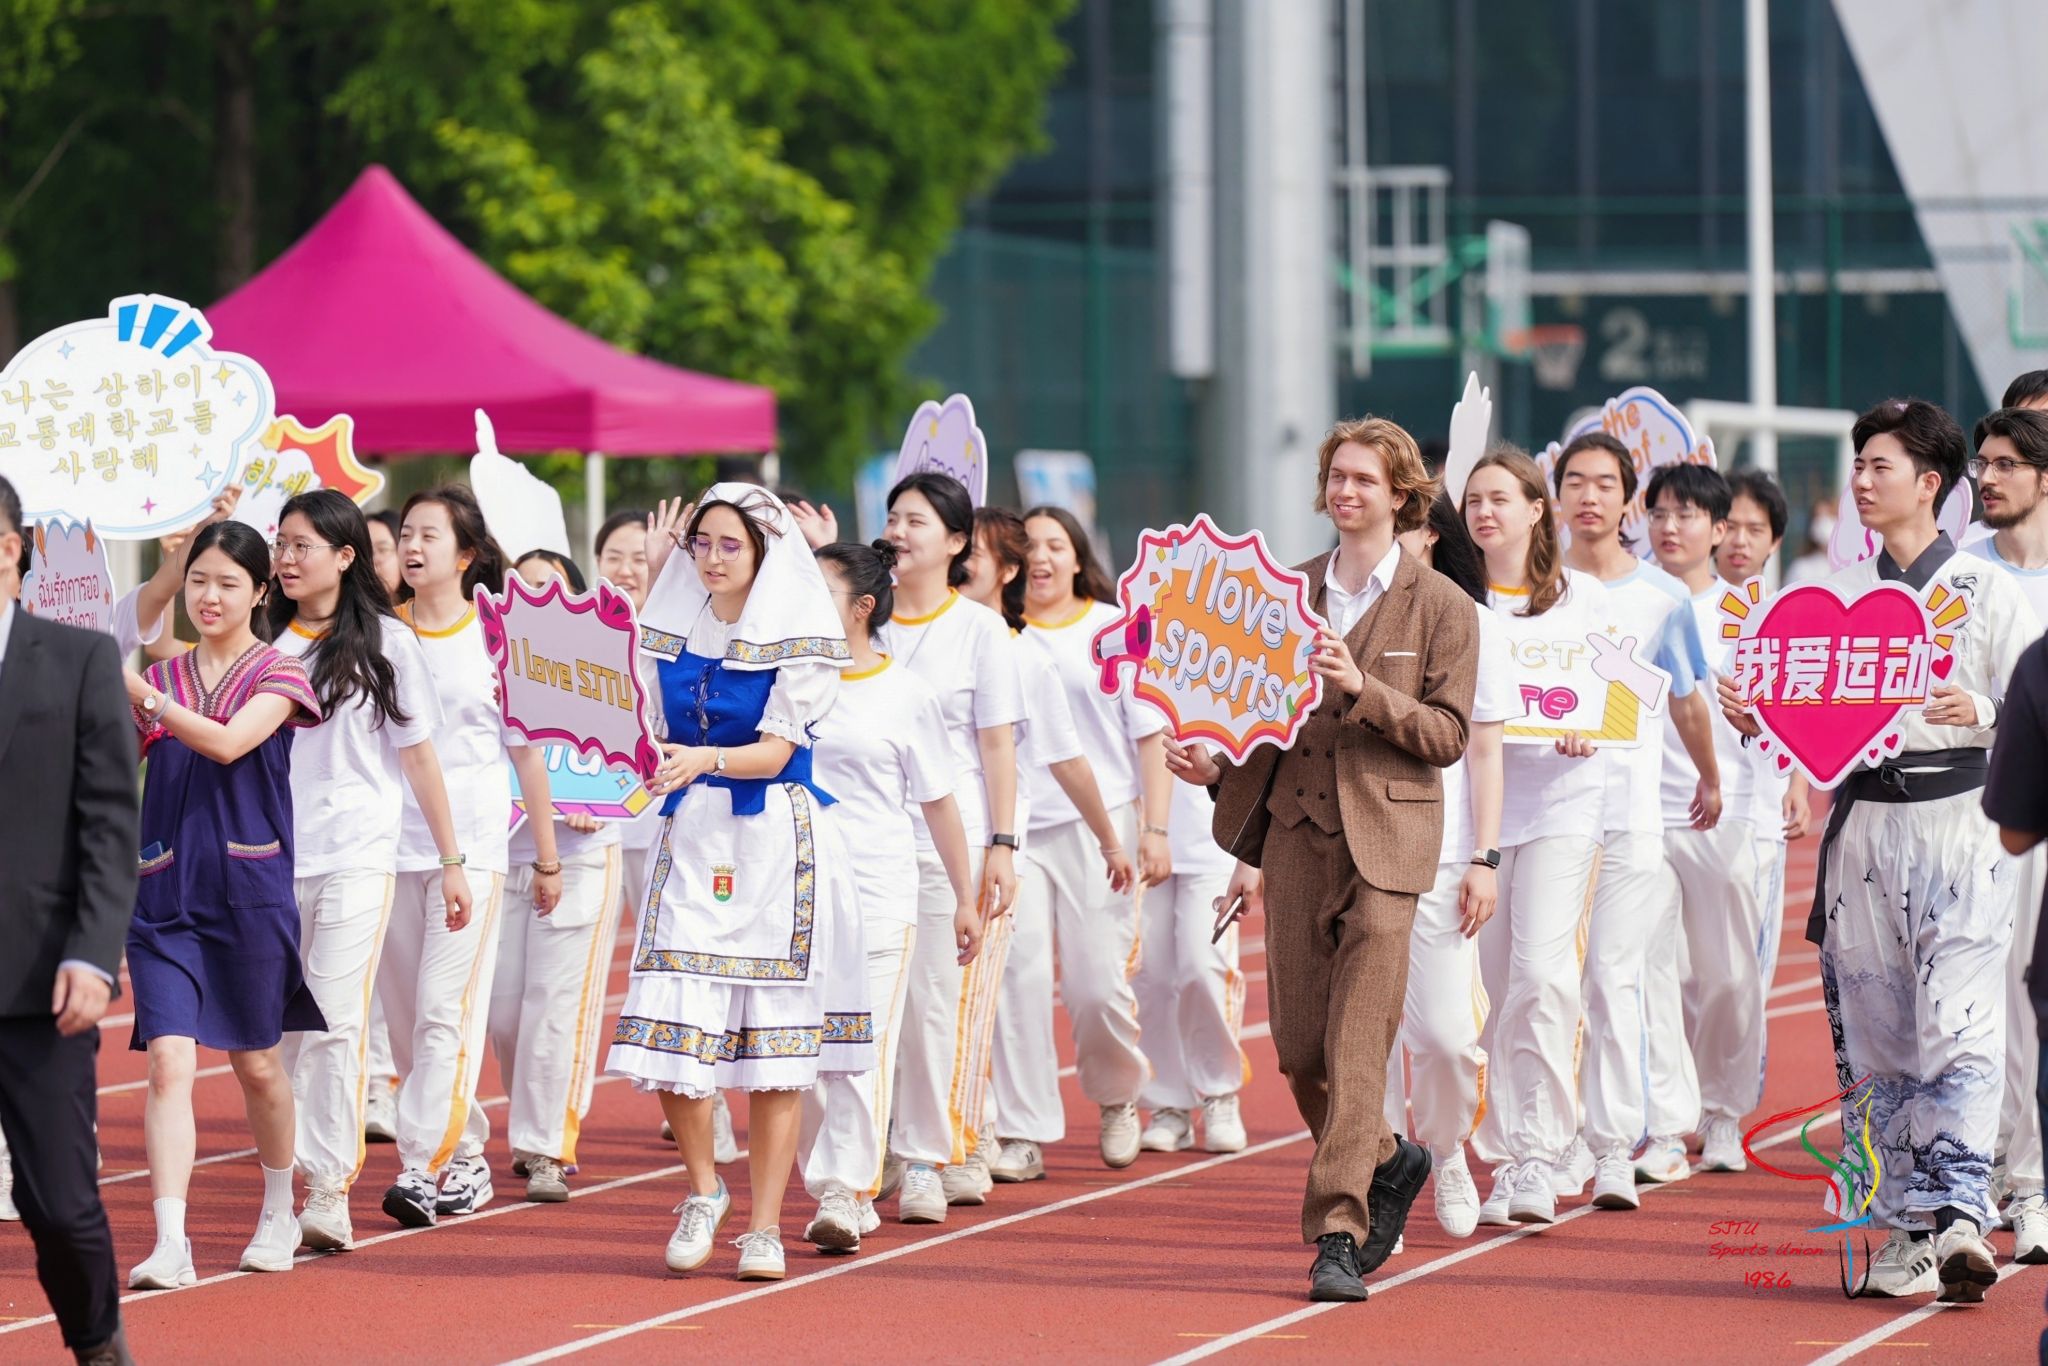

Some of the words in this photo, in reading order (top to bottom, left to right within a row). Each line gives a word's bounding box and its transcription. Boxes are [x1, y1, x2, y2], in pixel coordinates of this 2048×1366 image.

[1600, 306, 1649, 380] 2
[0, 400, 216, 450] 교통대학교를
[1, 380, 74, 415] 나는
[93, 365, 201, 408] 상하이
[50, 443, 158, 485] 사랑해
[1186, 543, 1208, 604] I
[1205, 550, 1288, 649] love
[510, 638, 520, 676] I
[575, 658, 633, 712] SJTU
[1159, 619, 1285, 722] sports
[1506, 637, 1585, 671] CT
[1735, 635, 1932, 707] 我爱运动
